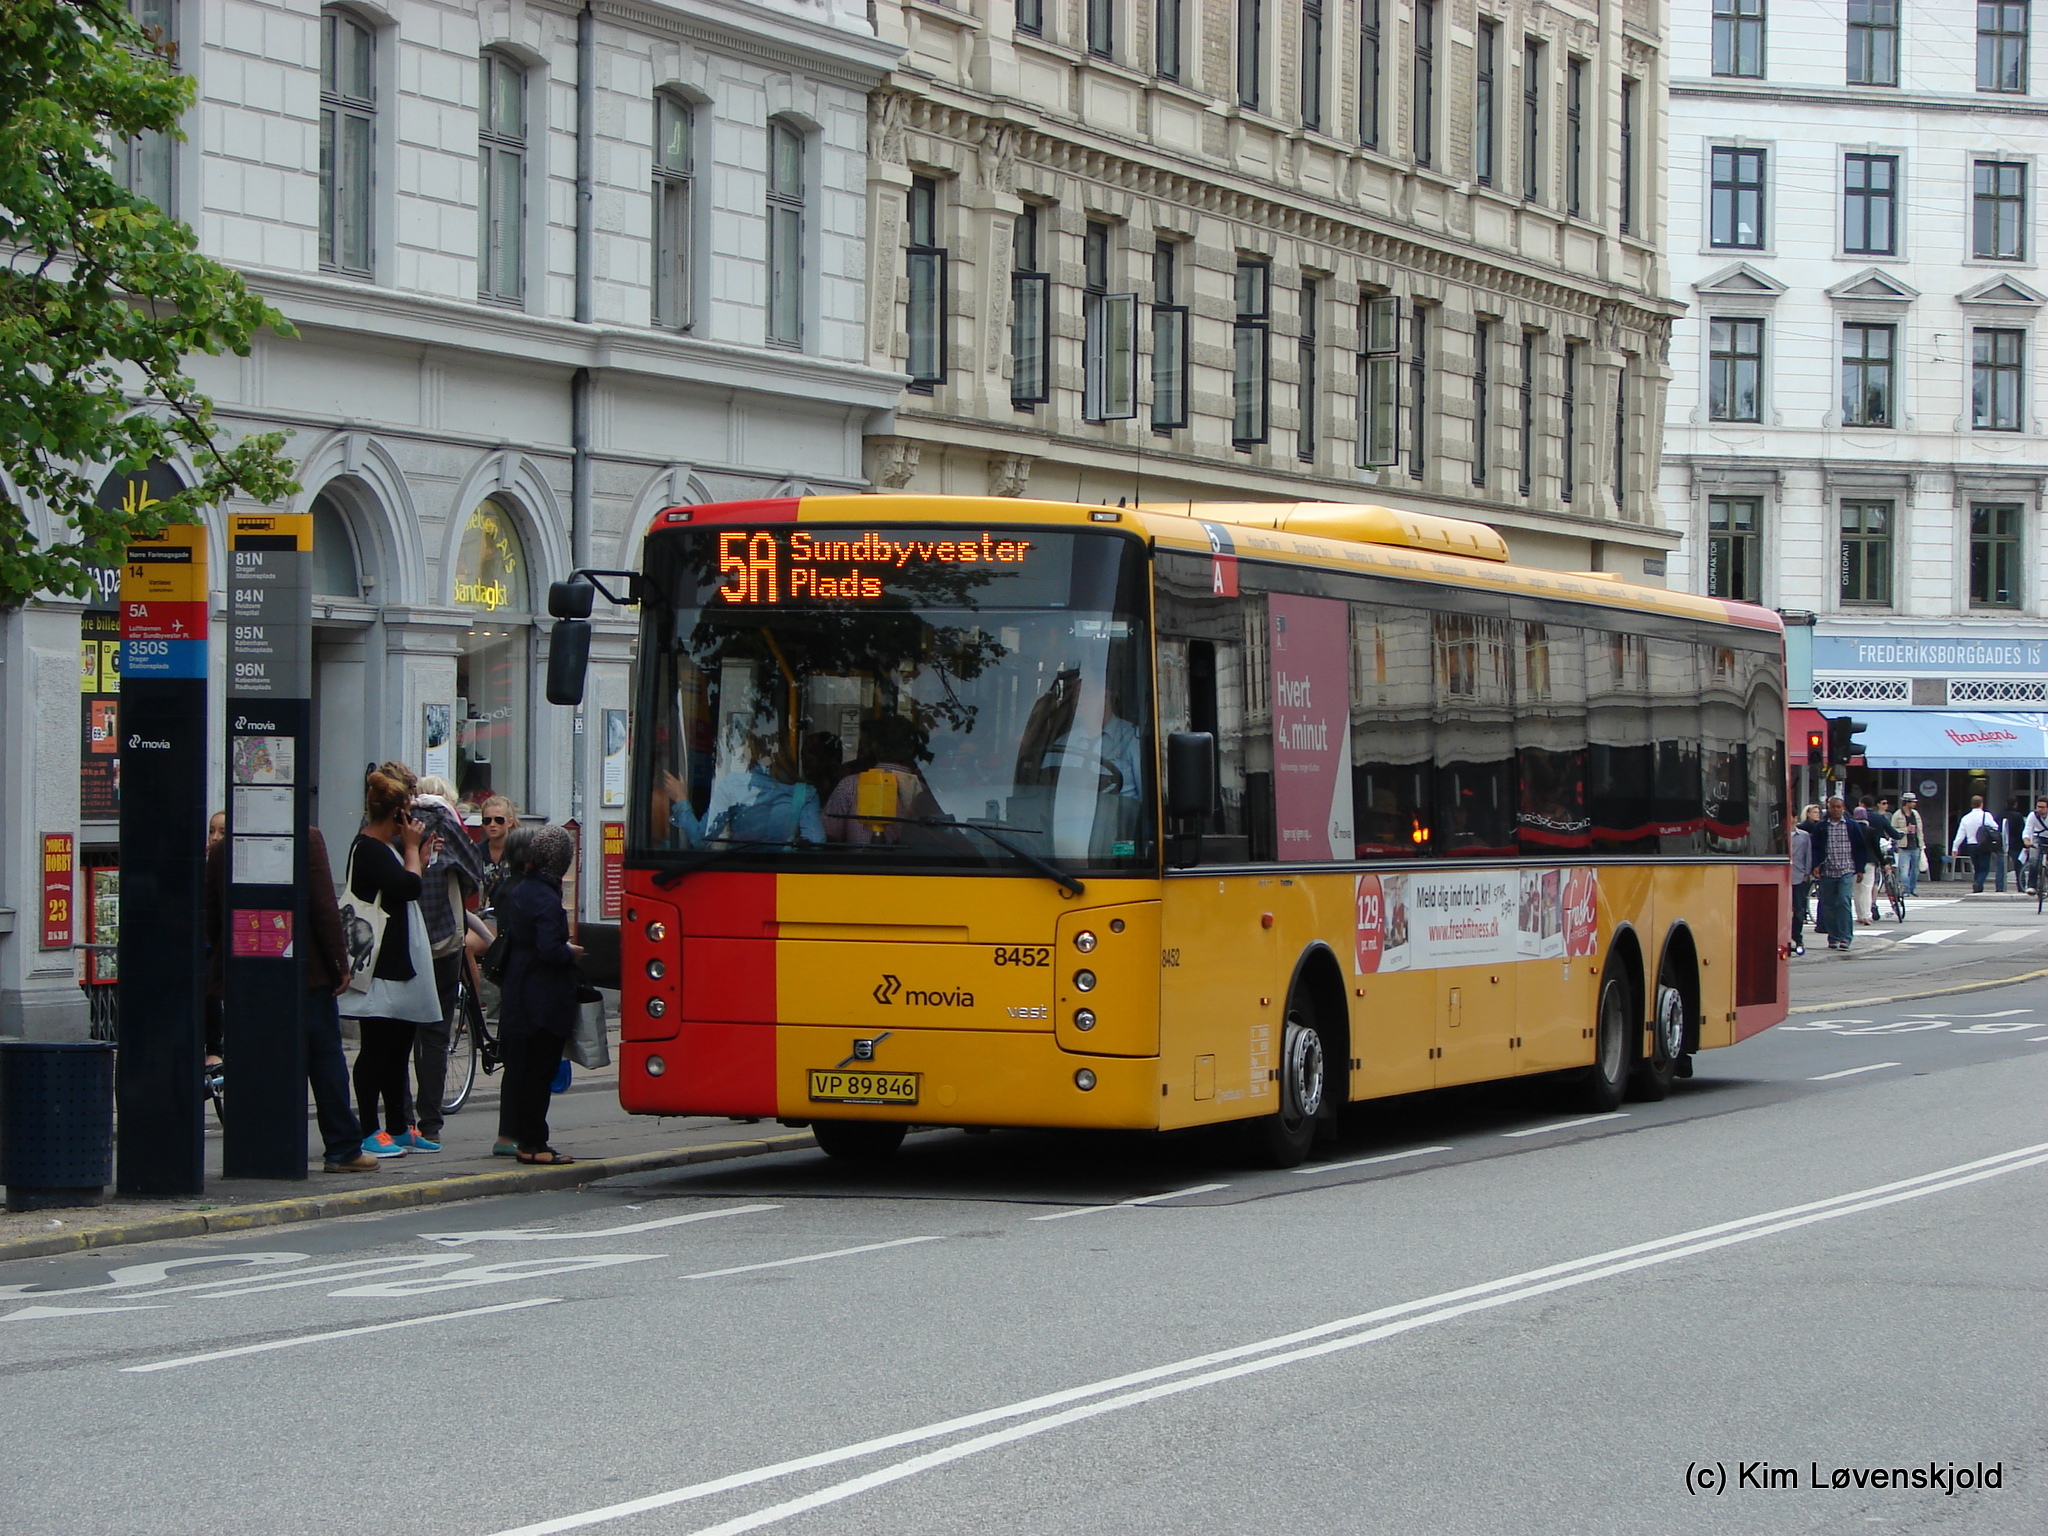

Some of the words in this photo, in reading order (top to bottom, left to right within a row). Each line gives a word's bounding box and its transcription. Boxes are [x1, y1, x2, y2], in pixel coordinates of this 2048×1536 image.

[1203, 523, 1221, 553] 5
[235, 552, 263, 566] 81N
[719, 531, 777, 603] 5A
[789, 531, 1031, 567] Sundbyvester
[128, 566, 144, 578] 14
[1213, 561, 1224, 594] A
[789, 568, 882, 598] Plads
[235, 590, 264, 602] 84N
[128, 604, 148, 618] 5A
[143, 632, 181, 640] Sundbyvester
[235, 626, 264, 639] 95N
[128, 641, 169, 655] 350S
[1859, 645, 2021, 665] FREDERIKSBORGGADES
[2028, 647, 2040, 665] IS
[129, 662, 169, 670] Stationsplads
[235, 663, 265, 676] 96N
[1276, 671, 1311, 708] Hvert
[247, 721, 276, 730] movia
[1278, 715, 1290, 749] 4.
[1291, 715, 1328, 751] minut
[142, 740, 170, 749] movia
[1944, 729, 2018, 747] Hansens
[1967, 760, 2041, 768] FREDERIKSBORGGADES
[45, 854, 71, 872] HOBBY
[1416, 885, 1436, 908] Meld
[1437, 885, 1449, 912] dig
[1450, 884, 1462, 906] ind
[1463, 884, 1474, 906] for
[1481, 883, 1491, 905] kr!
[49, 899, 67, 921] 23
[1563, 870, 1595, 945] fresh
[1428, 916, 1499, 941] www.freshfitness.dk
[994, 948, 1050, 967] 8452
[1162, 948, 1180, 968] 8452
[905, 986, 975, 1007] movia
[1007, 1004, 1048, 1019] vest
[816, 1075, 842, 1093] VP
[848, 1077, 872, 1095] 89
[876, 1078, 914, 1096] 846
